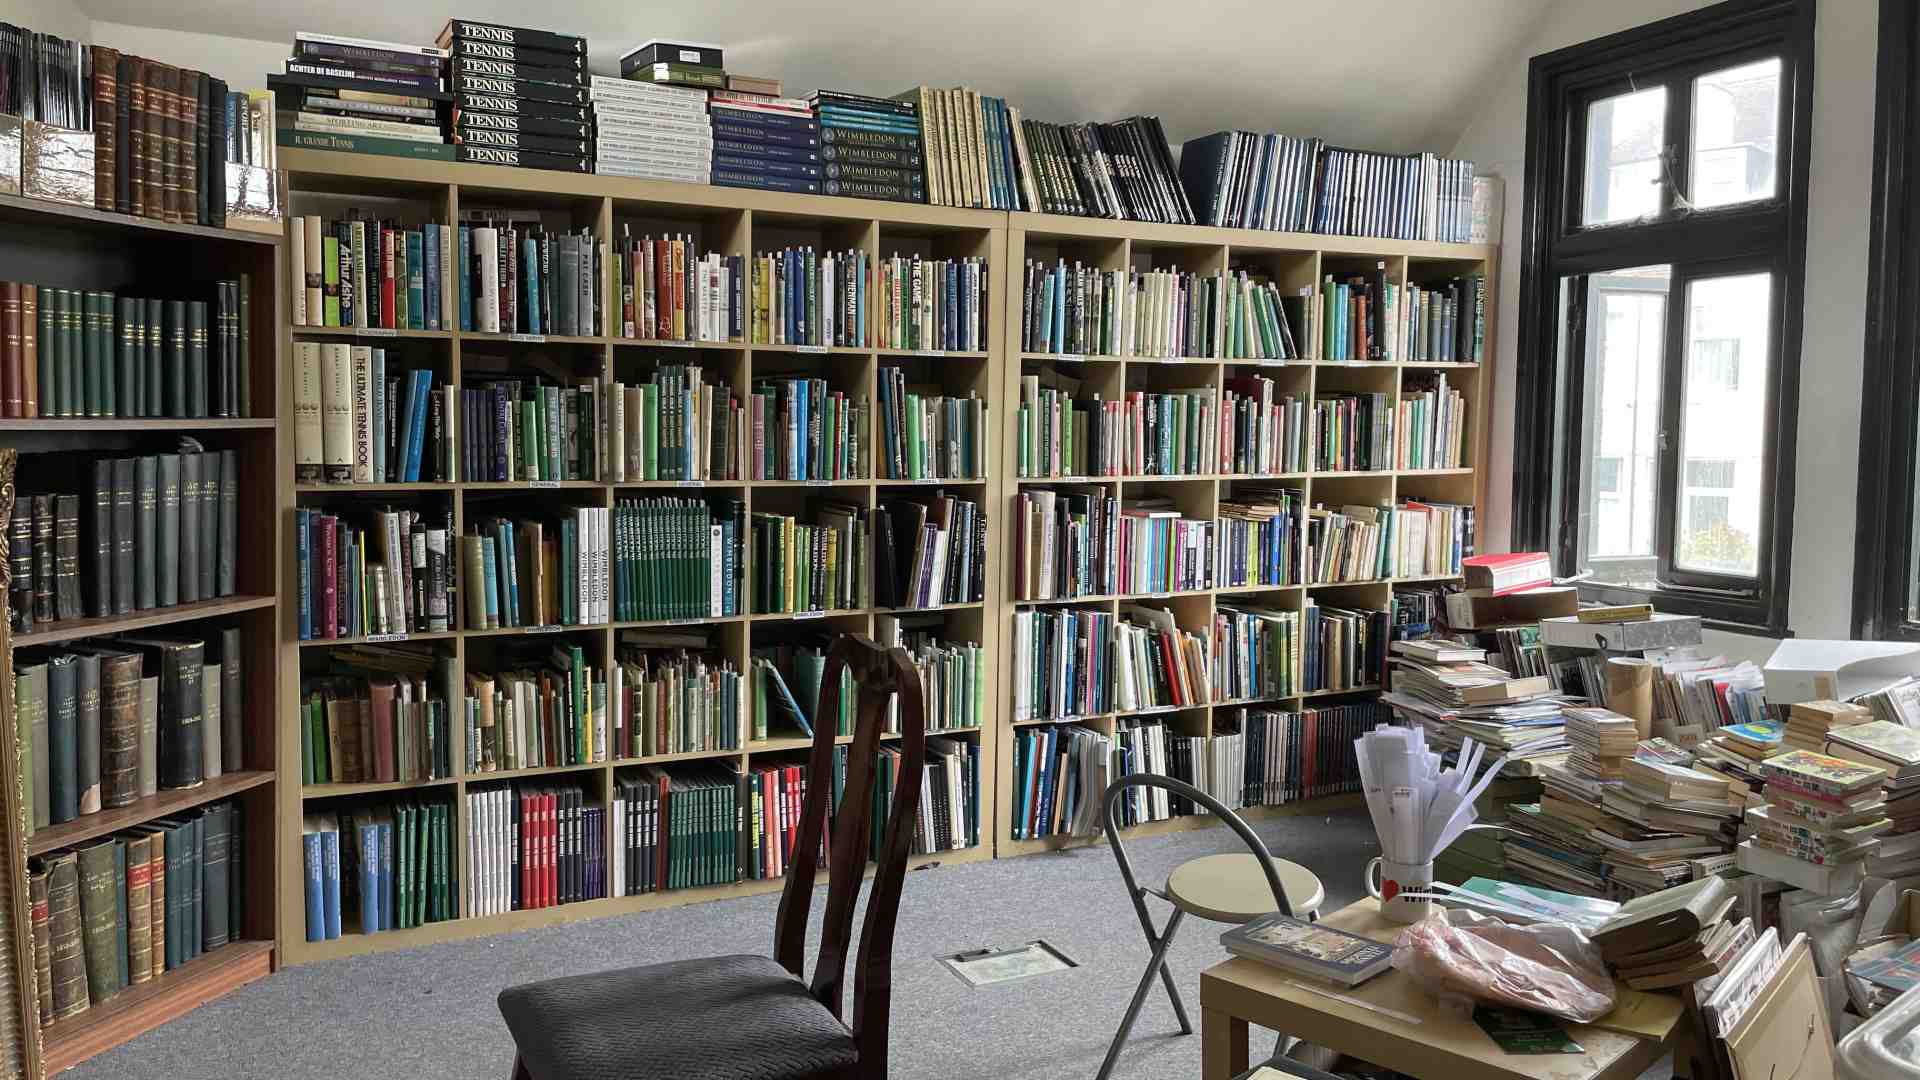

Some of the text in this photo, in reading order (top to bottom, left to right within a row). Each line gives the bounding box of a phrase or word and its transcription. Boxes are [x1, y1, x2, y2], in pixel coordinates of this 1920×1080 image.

[463, 24, 514, 42] TENNIS
[463, 40, 514, 59] TENNIS
[464, 58, 515, 76] TENNIS
[464, 76, 516, 93] TENNIS
[466, 95, 518, 112] TENNIS
[466, 113, 518, 129] TENNIS
[466, 129, 518, 146] TENNIS
[837, 129, 895, 144] WIMBLEDON
[466, 146, 518, 163] TENNIS
[838, 146, 896, 161] WIMBLEDON
[842, 165, 899, 177] WIMBLEDON
[842, 179, 899, 194] WIMBLEDON
[340, 244, 352, 308] Arthur Ashe
[912, 260, 921, 305] THE GAME
[356, 358, 367, 467] THE ULTIMATE TENNIS BOOK
